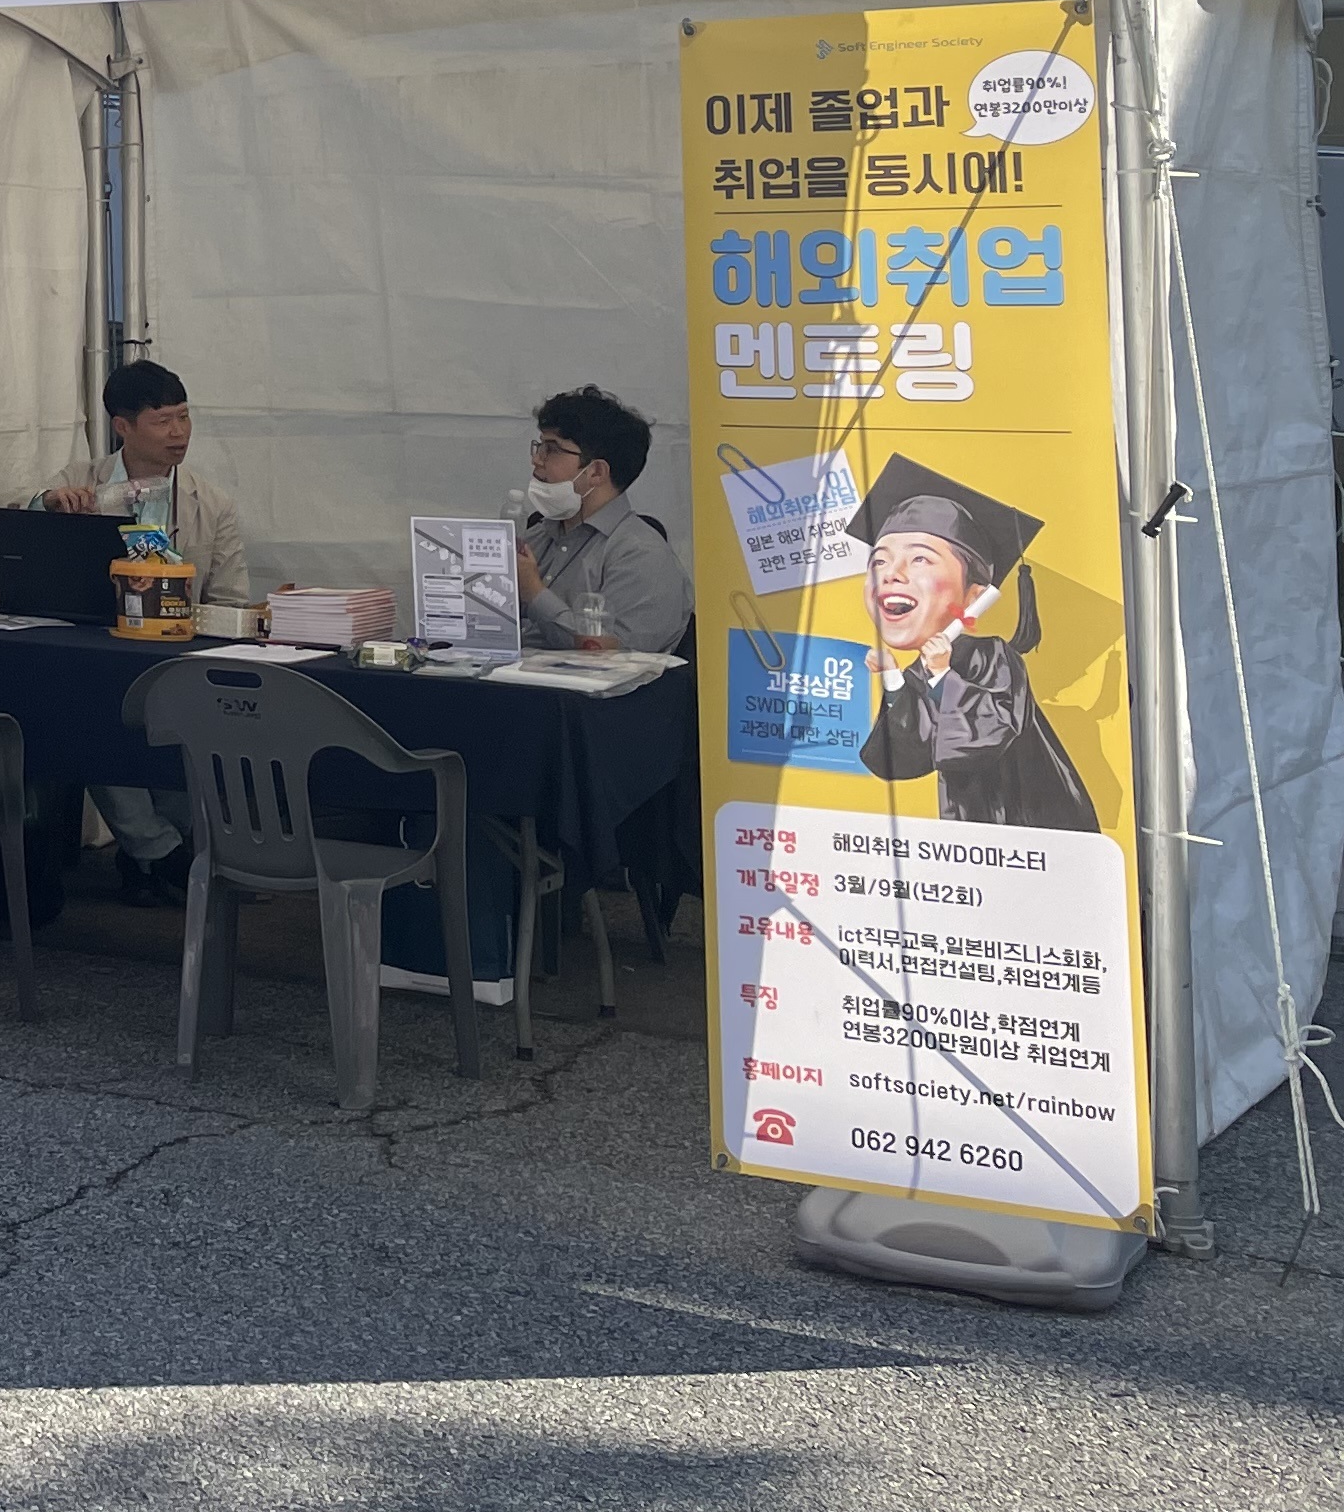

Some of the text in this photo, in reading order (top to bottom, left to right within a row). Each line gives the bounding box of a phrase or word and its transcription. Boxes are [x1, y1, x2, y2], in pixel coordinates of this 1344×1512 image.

[838, 35, 983, 53] Soft Engineer Society
[982, 76, 1067, 93] 취업률90%!
[706, 85, 950, 135] 이제 졸업과
[973, 97, 1089, 116] 연봉3200만이상
[713, 151, 1023, 199] 취업을 동시에!
[710, 224, 1064, 307] 해외취업
[713, 321, 975, 401] 멘토링
[826, 468, 848, 488] 01
[747, 487, 857, 525] 해외취업상담
[746, 517, 848, 552] 일본 해외 취업에
[758, 543, 853, 574] 관한 모든 상담!
[824, 657, 853, 678] 02
[766, 670, 855, 700] 과정상담
[745, 697, 843, 721] SWDO마스터
[739, 719, 859, 748] 과정에 대한 상담!
[735, 827, 797, 854] 과정명
[832, 832, 1047, 872] 해외취업 SWDO마스터
[736, 868, 820, 897] 개강일정
[834, 874, 983, 907] 3월/9월(년2회)
[738, 915, 815, 945] 교육내용
[837, 925, 1108, 974] ict직무교육,일본비즈니스회화,
[839, 947, 1101, 995] 이력서,면접컨설팅,취업연계등
[740, 984, 779, 1010] 특징
[842, 995, 1080, 1043] 취업률90%이상,학점연계
[843, 1018, 1111, 1074] 연봉3200만원이상 취업연계
[742, 1056, 824, 1087] 홈페이지
[849, 1071, 1116, 1123] softsociety.net/rainbow
[851, 1126, 1024, 1173] 062 942 6260
